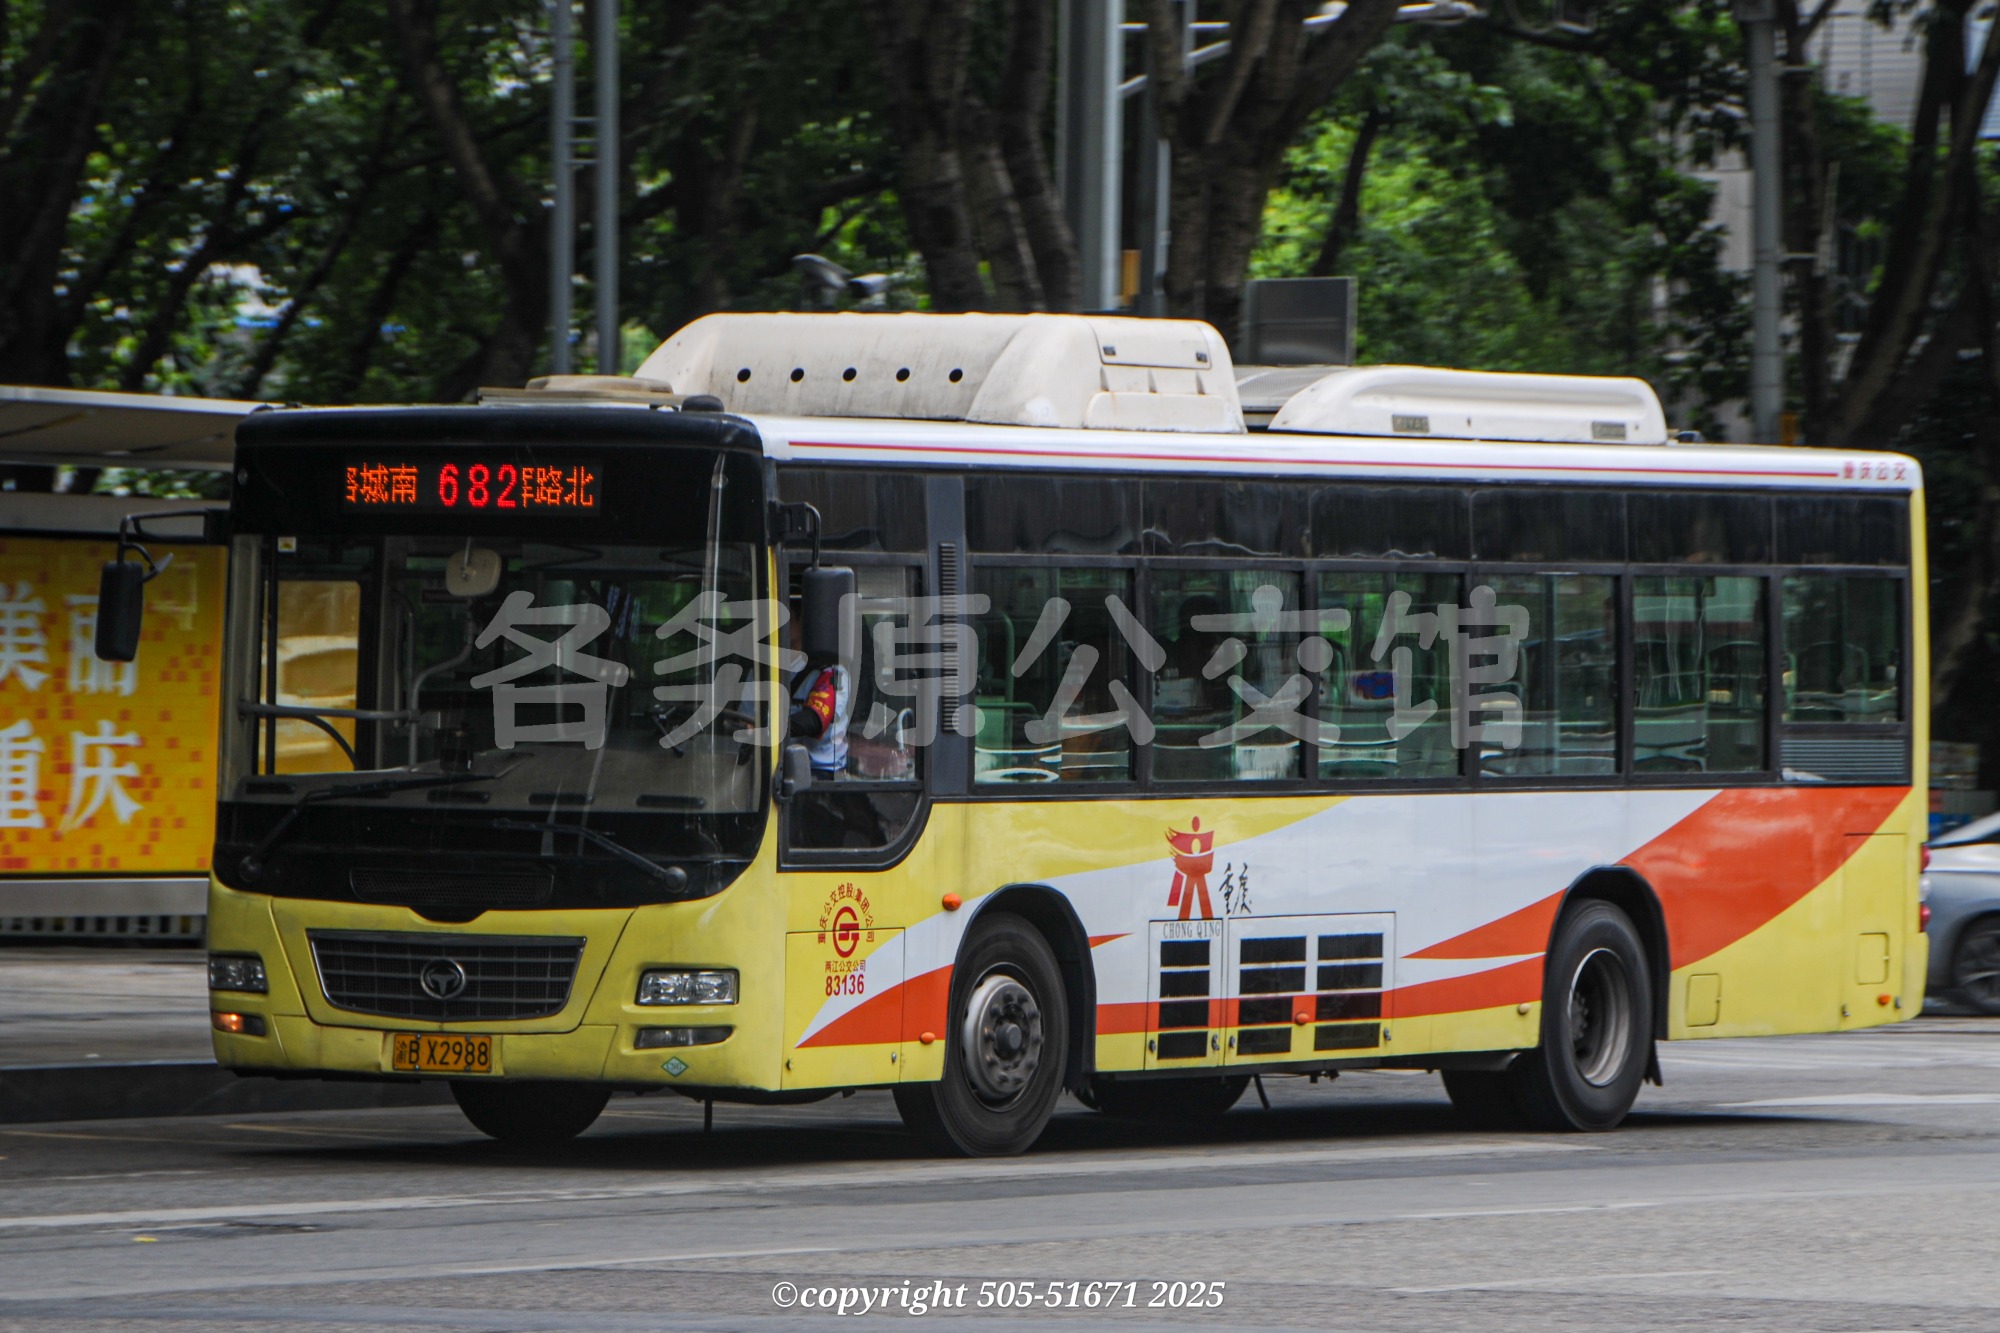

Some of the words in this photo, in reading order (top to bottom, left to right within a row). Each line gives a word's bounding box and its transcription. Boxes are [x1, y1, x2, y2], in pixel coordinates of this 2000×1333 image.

[439, 463, 517, 508] 682
[1163, 922, 1193, 939] CHONG
[1197, 921, 1221, 938] QING
[825, 973, 865, 997] 83136
[426, 1040, 489, 1066] X2988
